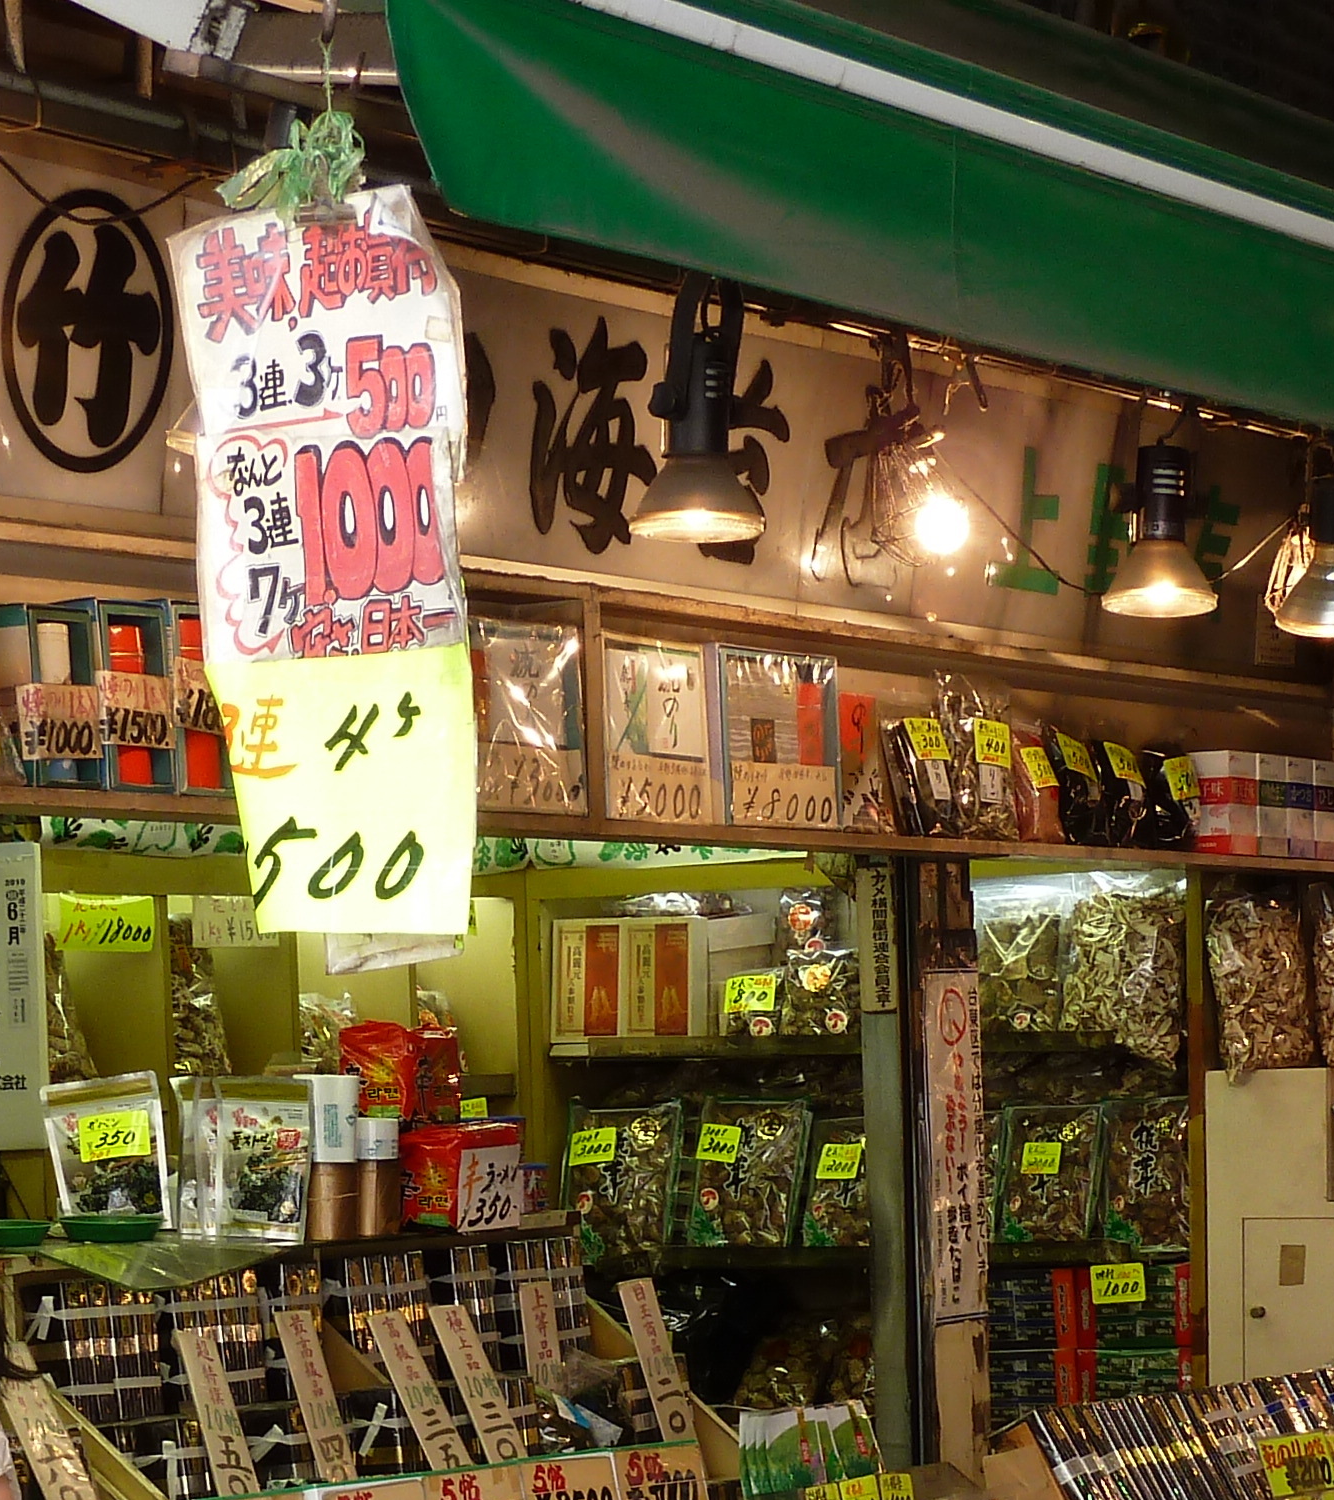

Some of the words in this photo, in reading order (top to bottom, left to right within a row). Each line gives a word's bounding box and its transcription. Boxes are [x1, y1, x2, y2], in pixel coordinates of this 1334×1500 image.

[15, 220, 163, 450] 竹
[227, 452, 284, 488] なんと
[246, 497, 300, 554] 3連
[743, 787, 832, 823] ¥8000
[246, 815, 423, 913] 500
[7, 902, 20, 945] 6月
[368, 1088, 400, 1100] 라면
[419, 1195, 451, 1209] 라면
[531, 1288, 553, 1360] 上等品
[532, 1464, 566, 1493] 5帖
[627, 1452, 667, 1486] 5帖
